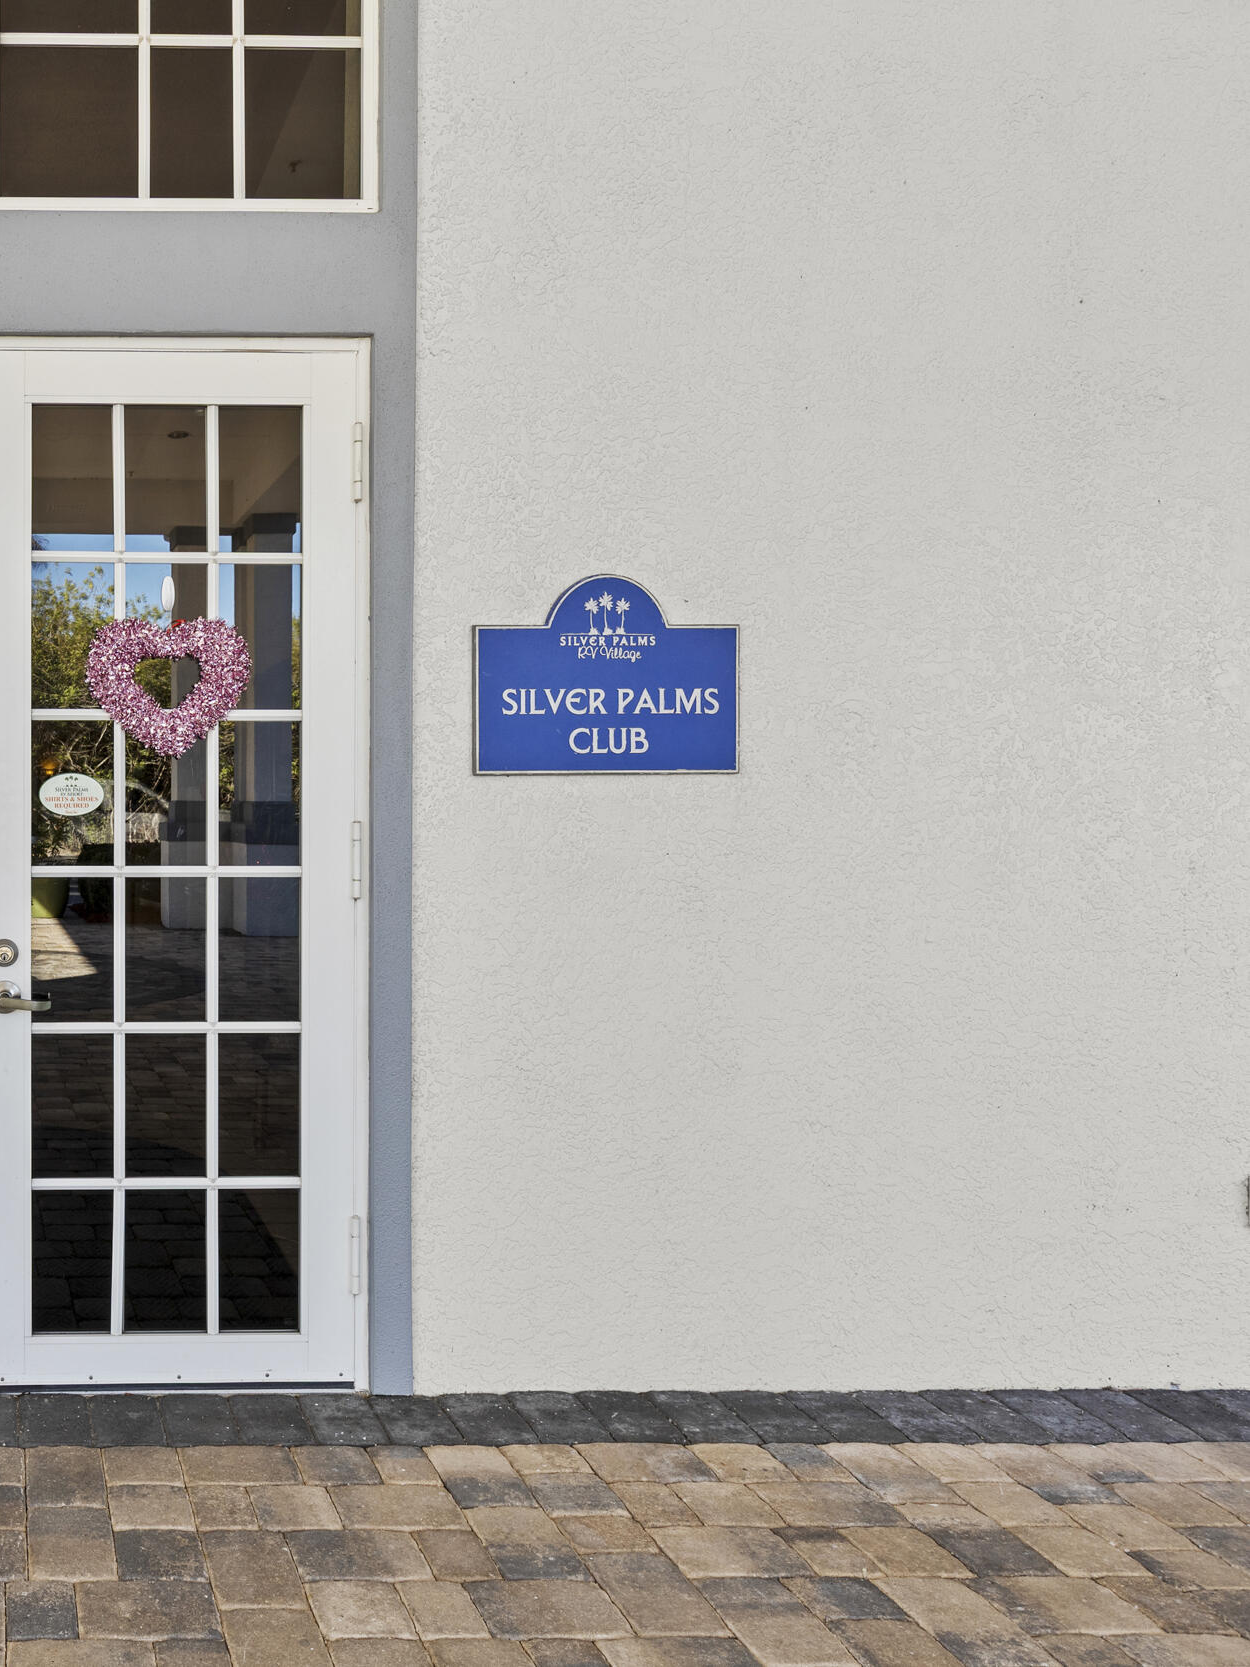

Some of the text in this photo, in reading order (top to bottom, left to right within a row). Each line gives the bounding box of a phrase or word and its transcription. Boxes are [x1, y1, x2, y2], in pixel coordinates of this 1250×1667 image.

[560, 636, 656, 647] SILVER PALMS
[578, 646, 642, 662] RV Village
[501, 687, 720, 716] SILVER PALMS
[568, 727, 649, 754] CLUB
